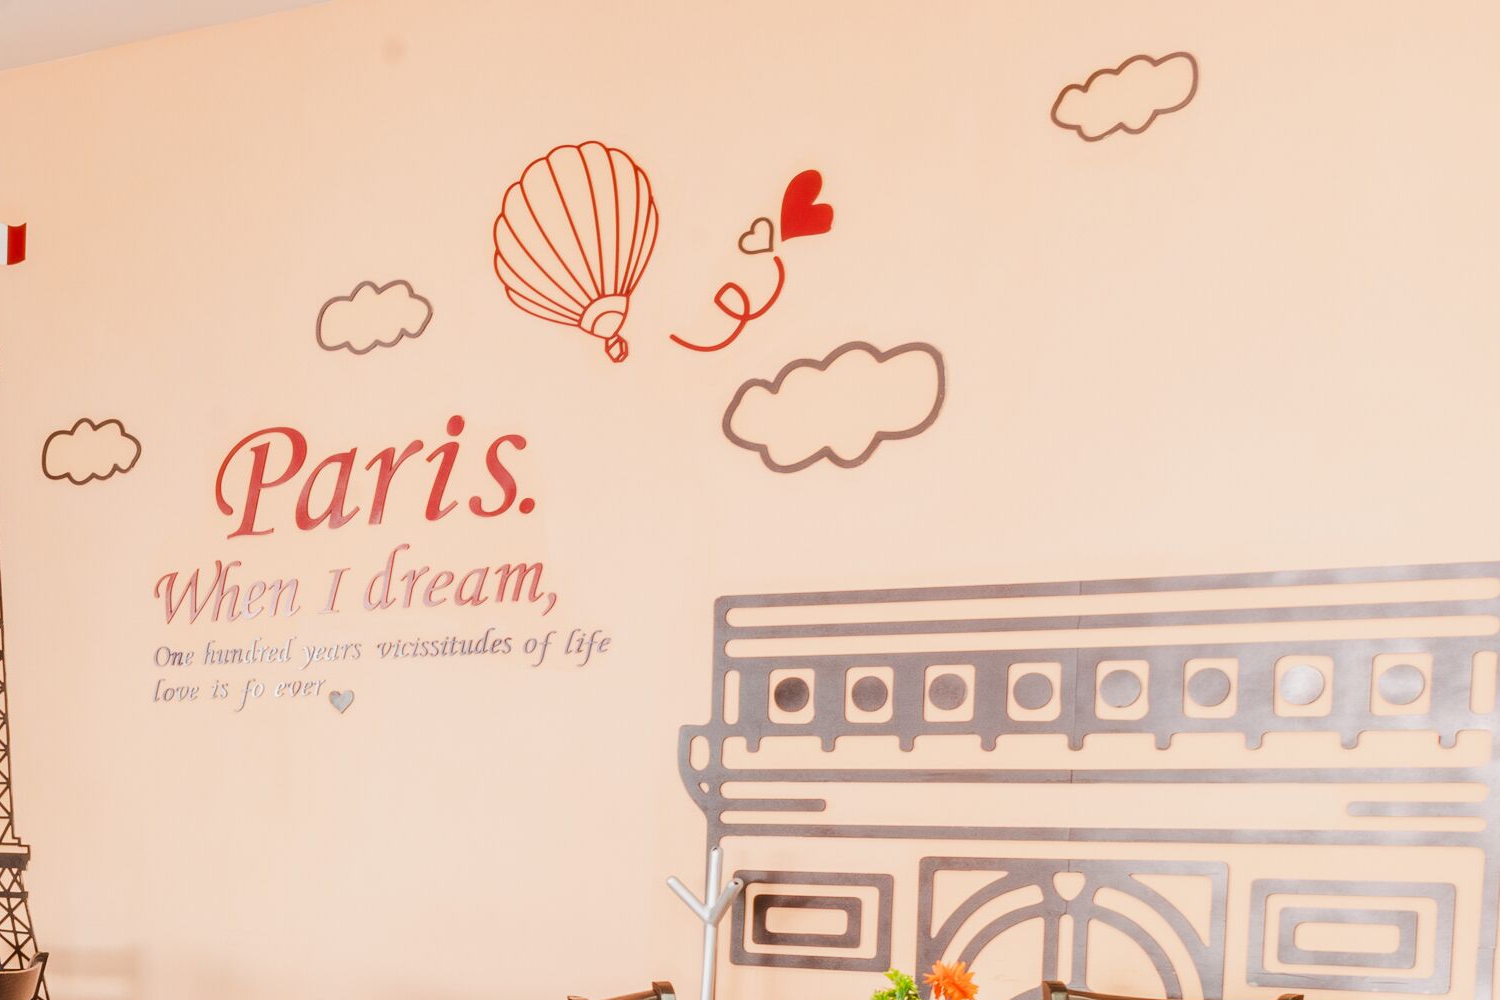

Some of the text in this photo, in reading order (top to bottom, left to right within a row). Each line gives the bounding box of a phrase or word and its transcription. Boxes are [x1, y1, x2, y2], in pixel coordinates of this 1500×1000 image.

[215, 414, 536, 540] Paris.
[153, 543, 558, 625] When I dream,
[153, 627, 612, 671] One hundred years vicissitudes of life
[152, 678, 200, 703] love
[211, 679, 229, 699] is
[274, 678, 327, 698] ever
